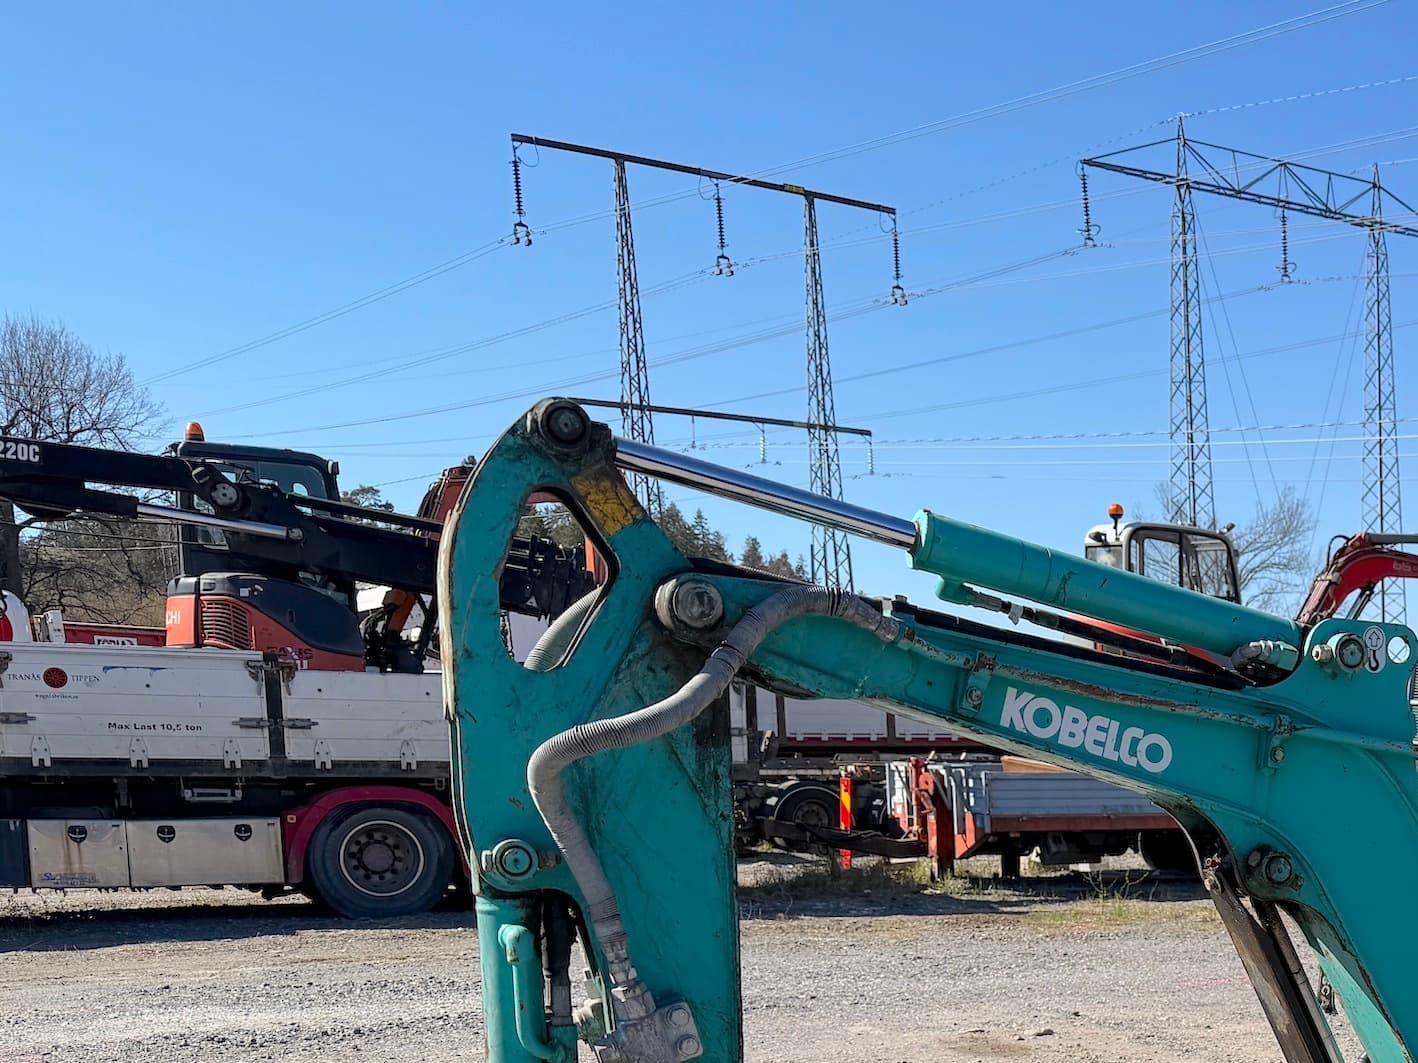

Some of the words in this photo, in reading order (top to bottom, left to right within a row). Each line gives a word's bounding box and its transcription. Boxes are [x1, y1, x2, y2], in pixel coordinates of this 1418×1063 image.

[107, 722, 131, 730] Max
[133, 723, 157, 731] Last
[1000, 686, 1173, 773] KOBELCO
